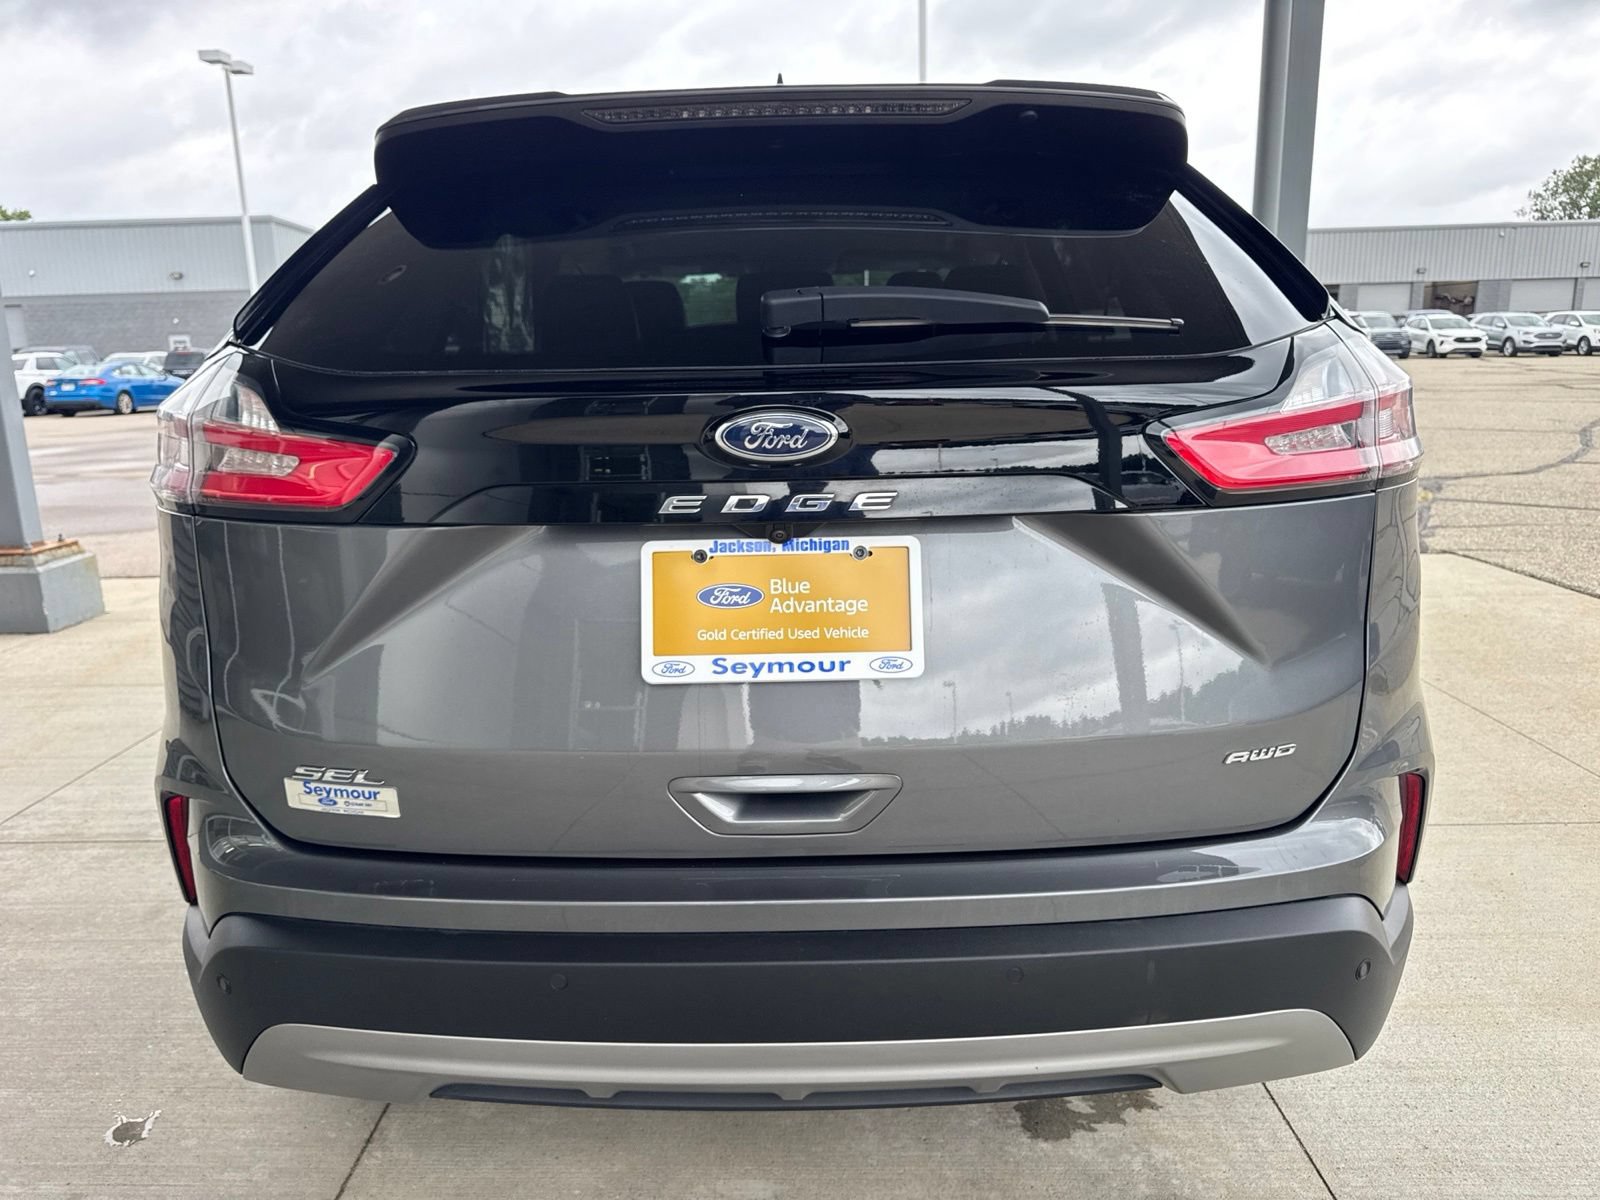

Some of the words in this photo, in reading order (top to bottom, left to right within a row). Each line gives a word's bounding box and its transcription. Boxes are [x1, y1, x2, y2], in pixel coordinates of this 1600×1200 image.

[743, 421, 809, 450] Ford
[658, 491, 898, 514] EDGE
[709, 540, 776, 553] Jackson,
[782, 538, 850, 553] Michigan
[710, 587, 752, 605] Ford
[769, 578, 810, 595] Blue
[769, 597, 869, 615] Advantage
[697, 629, 727, 641] Gold
[730, 627, 784, 640] Certified
[788, 627, 820, 640] Used
[824, 626, 869, 639] Vehicle
[660, 663, 688, 675] Ford
[712, 657, 851, 678] Seymour
[878, 659, 905, 671] Ford
[1225, 743, 1297, 764] AWD
[292, 766, 385, 785] SEL
[303, 781, 380, 800] Seymour
